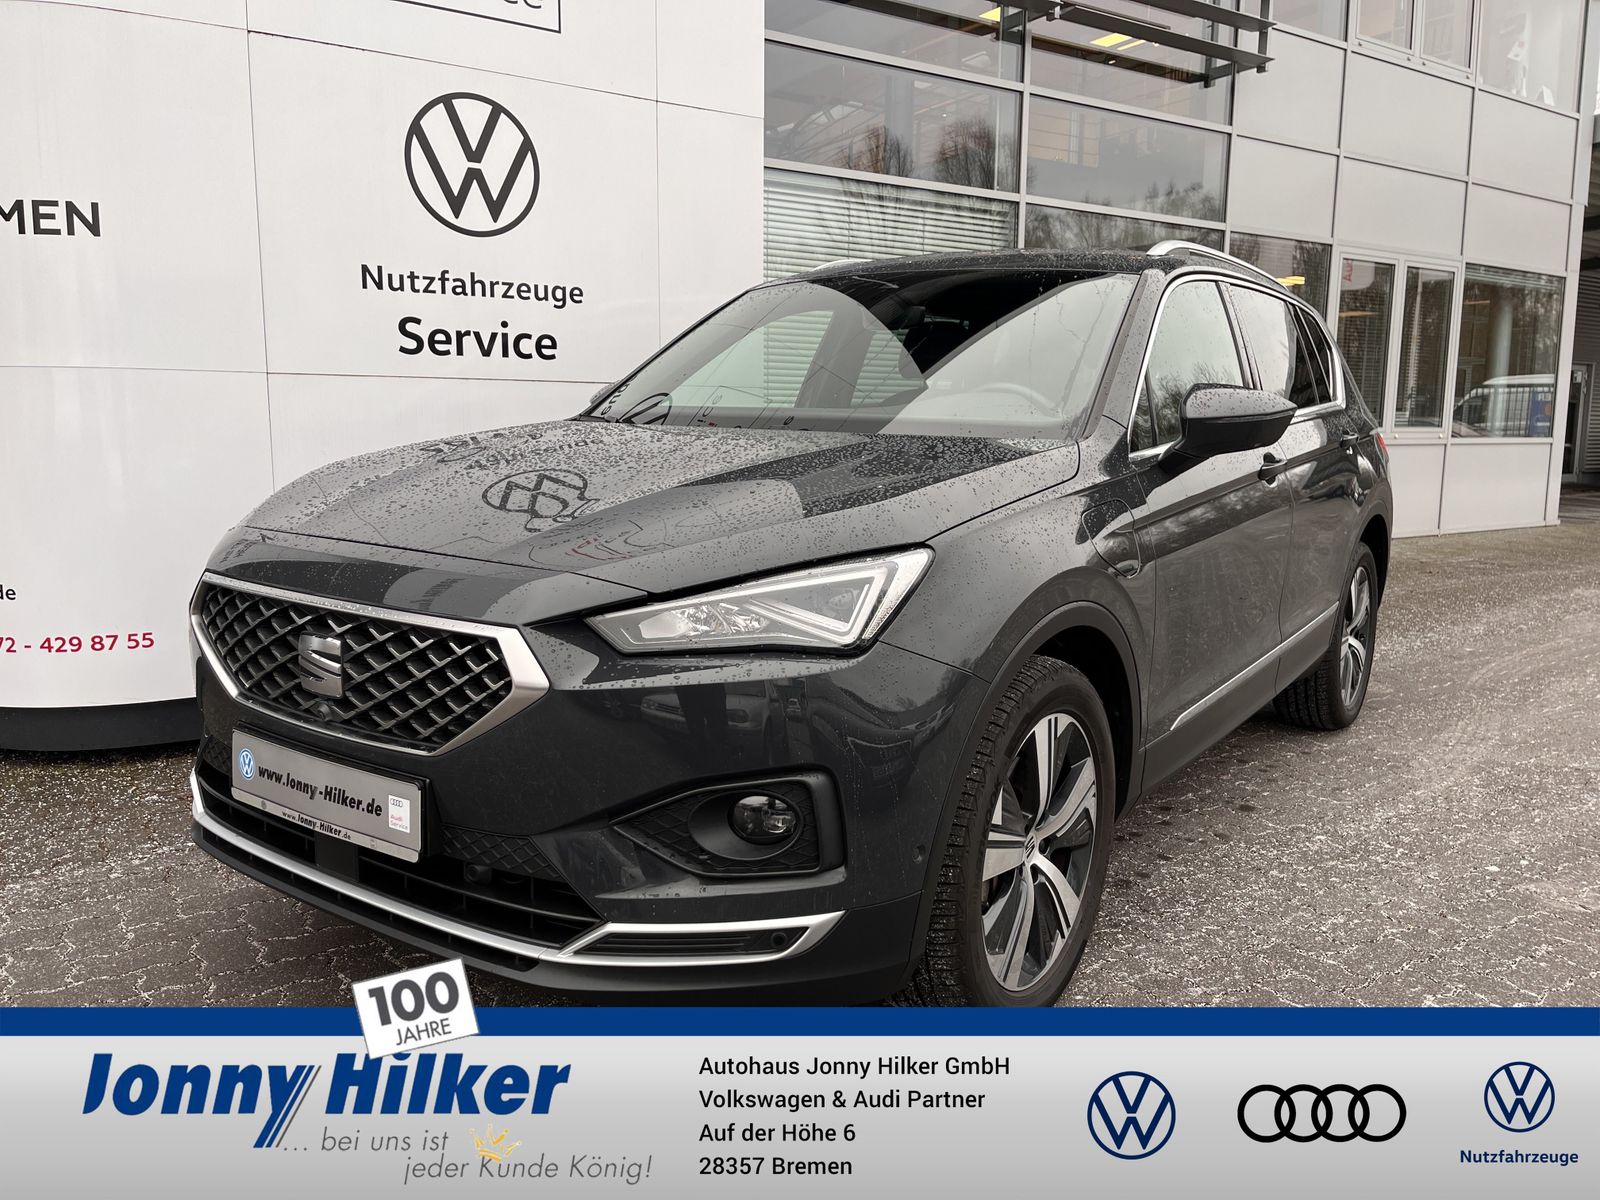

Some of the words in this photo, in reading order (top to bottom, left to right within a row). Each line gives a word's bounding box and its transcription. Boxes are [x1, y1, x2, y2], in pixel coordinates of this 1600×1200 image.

[360, 263, 584, 309] Nutzfahrzeuge
[397, 316, 558, 361] Service
[39, 636, 83, 653] 429
[90, 635, 118, 651] 87
[127, 632, 155, 649] 55
